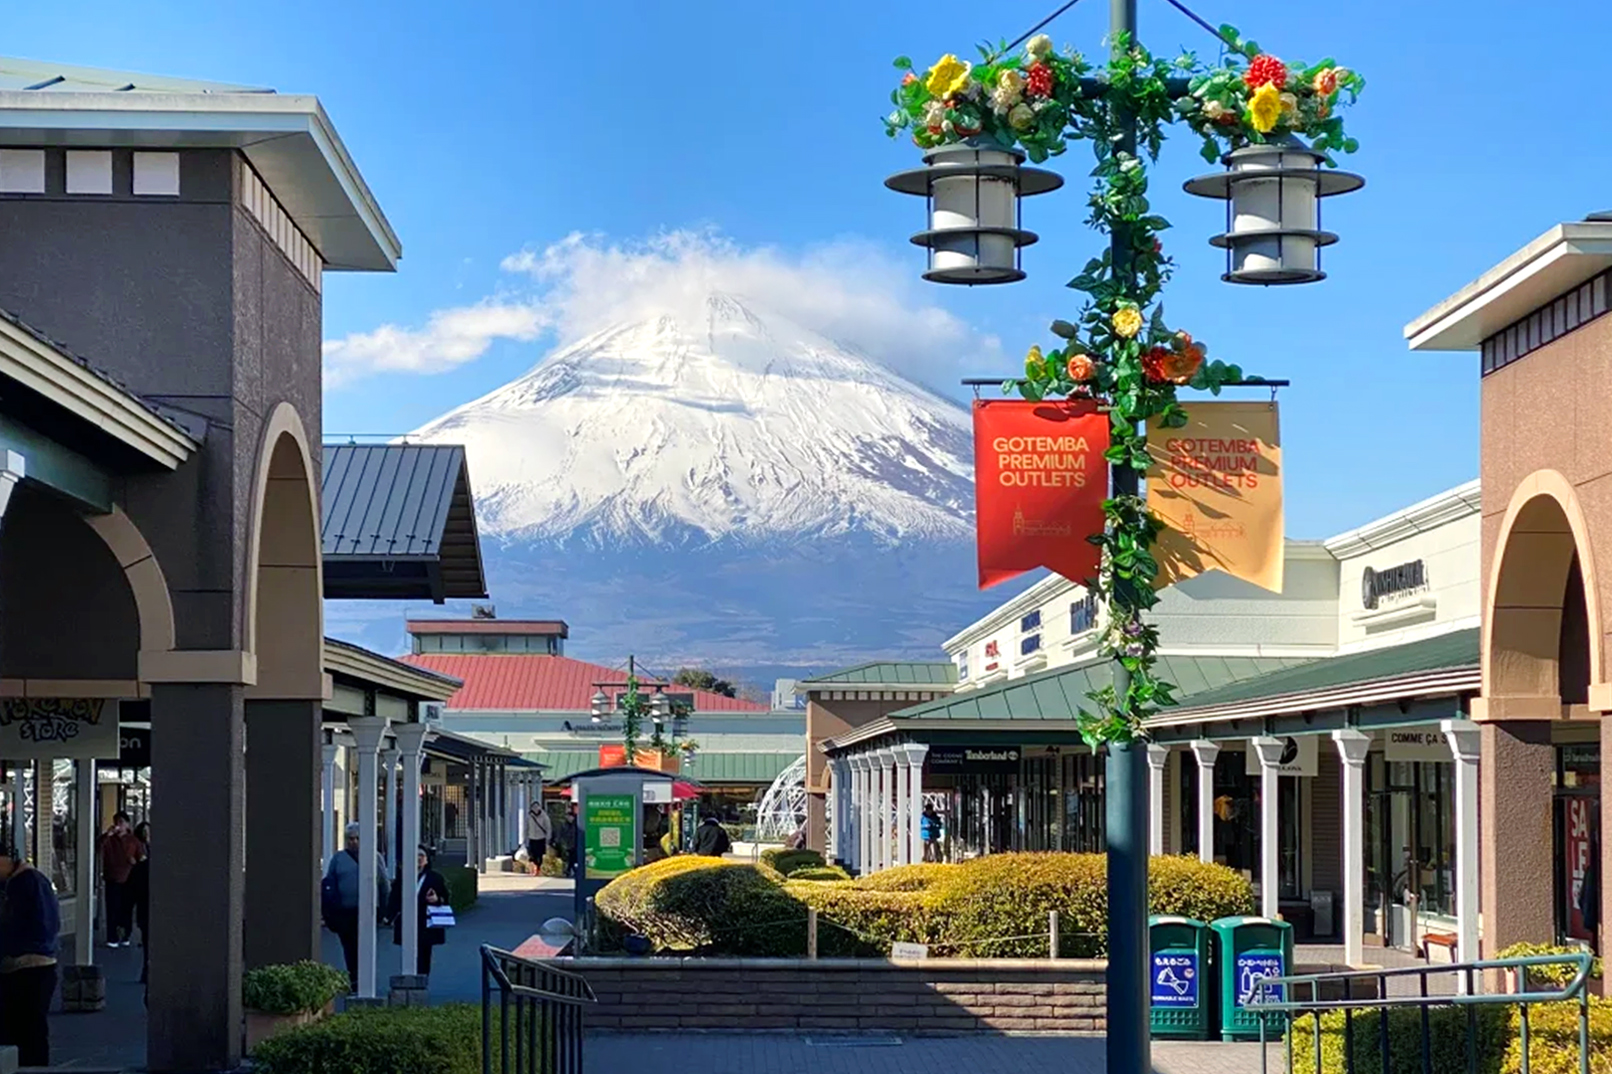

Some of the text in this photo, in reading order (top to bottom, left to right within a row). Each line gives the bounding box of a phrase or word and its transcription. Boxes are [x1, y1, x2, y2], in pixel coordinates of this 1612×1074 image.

[993, 437, 1090, 452] GOTEMBA
[1166, 438, 1259, 453] GOTEMBA
[998, 454, 1085, 470] PREMIUM
[1171, 455, 1257, 471] PREMIUM
[999, 471, 1085, 487] OUTLETS
[1171, 473, 1257, 488] OUTLETS
[1391, 732, 1423, 743] COMME
[1425, 733, 1438, 746] ÇA
[965, 749, 1007, 760] Timberland
